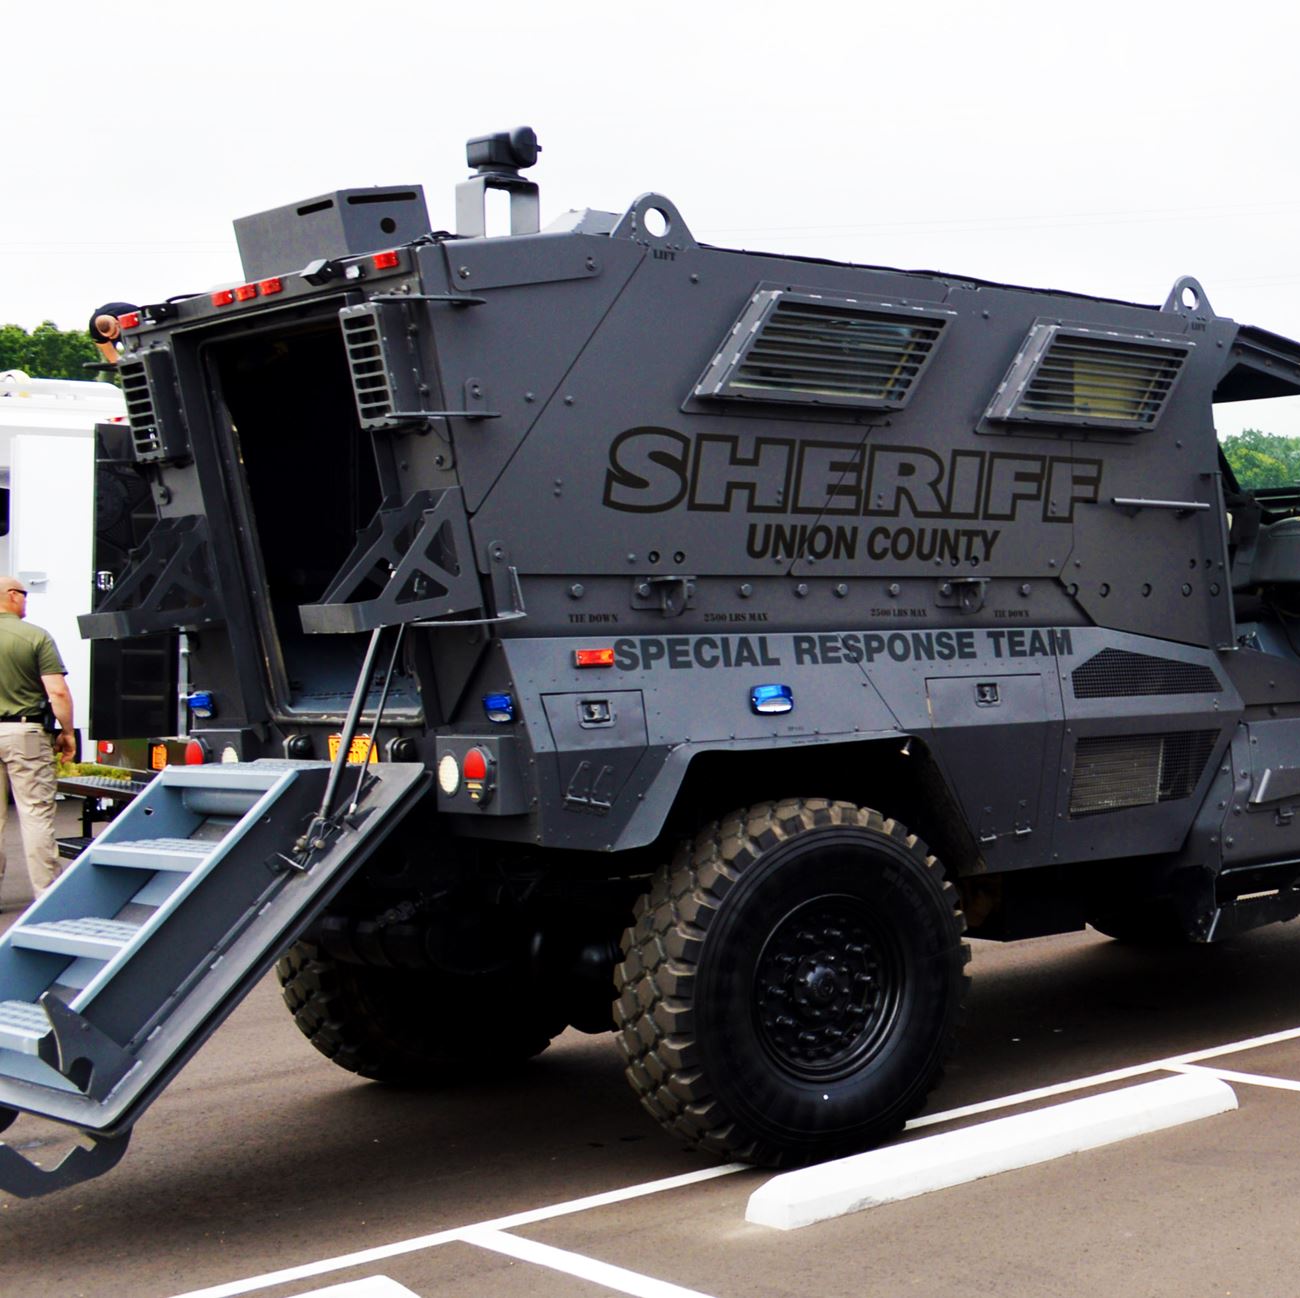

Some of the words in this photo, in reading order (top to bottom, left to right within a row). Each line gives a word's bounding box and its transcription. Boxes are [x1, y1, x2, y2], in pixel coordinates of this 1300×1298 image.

[653, 249, 676, 261] LIFT
[602, 425, 1103, 523] SHERIFF
[745, 523, 859, 560] UNION
[866, 525, 1002, 562] COUNTY
[568, 613, 586, 623] TIE
[589, 613, 618, 623] DOWN
[704, 613, 727, 622] 2500
[729, 613, 746, 622] LBS
[748, 613, 768, 622] MAX
[909, 608, 927, 617] MAX
[993, 609, 1006, 618] TIE
[1008, 609, 1029, 618] DOWN
[614, 636, 781, 671] SPECIAL
[793, 631, 977, 665] RESPONSE
[987, 629, 1074, 658] TEAM
